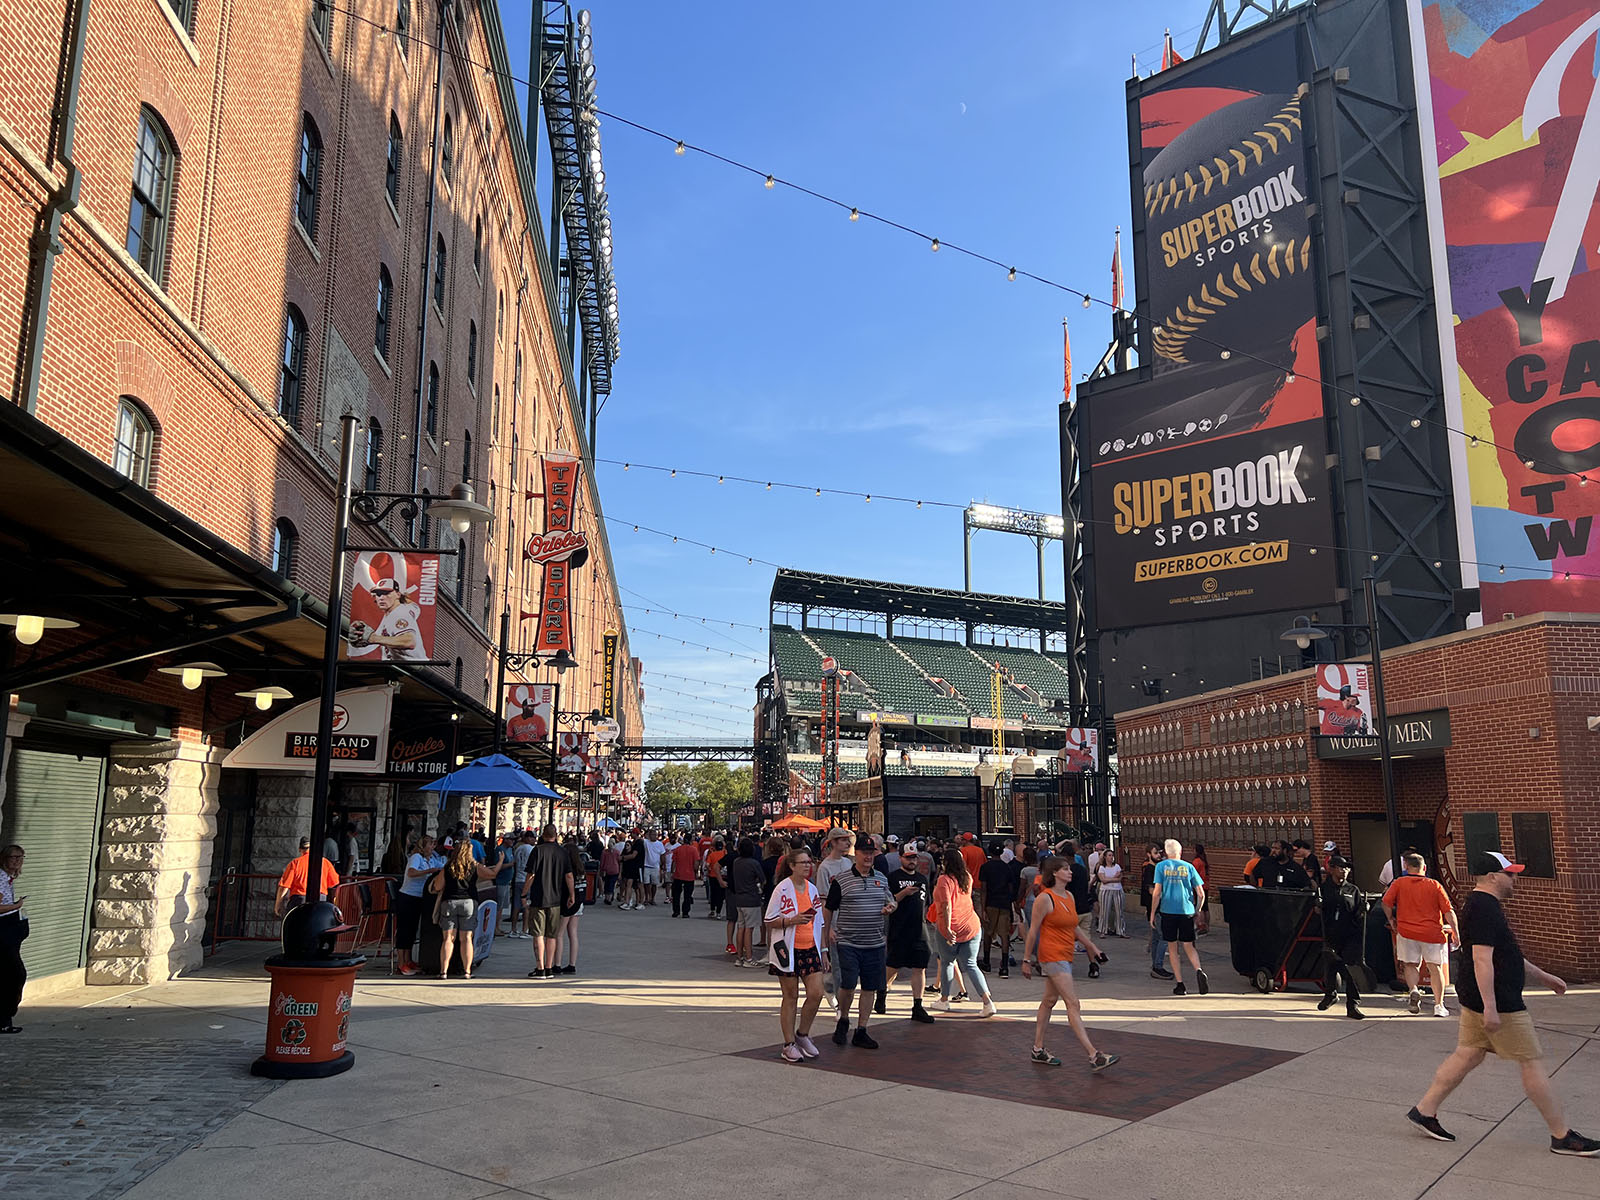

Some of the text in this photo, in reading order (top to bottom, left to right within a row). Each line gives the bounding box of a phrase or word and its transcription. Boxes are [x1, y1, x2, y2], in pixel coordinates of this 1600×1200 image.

[1160, 165, 1304, 268] SUPERBOOK
[1194, 218, 1274, 267] SPORTS
[551, 466, 569, 527] TEAM
[1113, 444, 1308, 535] SUPERBOOK
[530, 532, 586, 560] Orioles
[1154, 511, 1260, 547] SPORTS
[1139, 544, 1284, 578] SUPERBOOK.COM
[418, 559, 439, 606] GUNNAR
[546, 565, 564, 644] STORE
[603, 637, 614, 717] SUPERBOOK
[1356, 667, 1368, 691] ADLEY
[294, 735, 370, 748] BIRLAND
[1395, 720, 1433, 744] MEN
[391, 736, 446, 763] Orioles
[389, 761, 448, 774] TEAM STORE
[283, 1002, 319, 1016] GREEN
[275, 1046, 311, 1055] PLEASE RECYCLE
